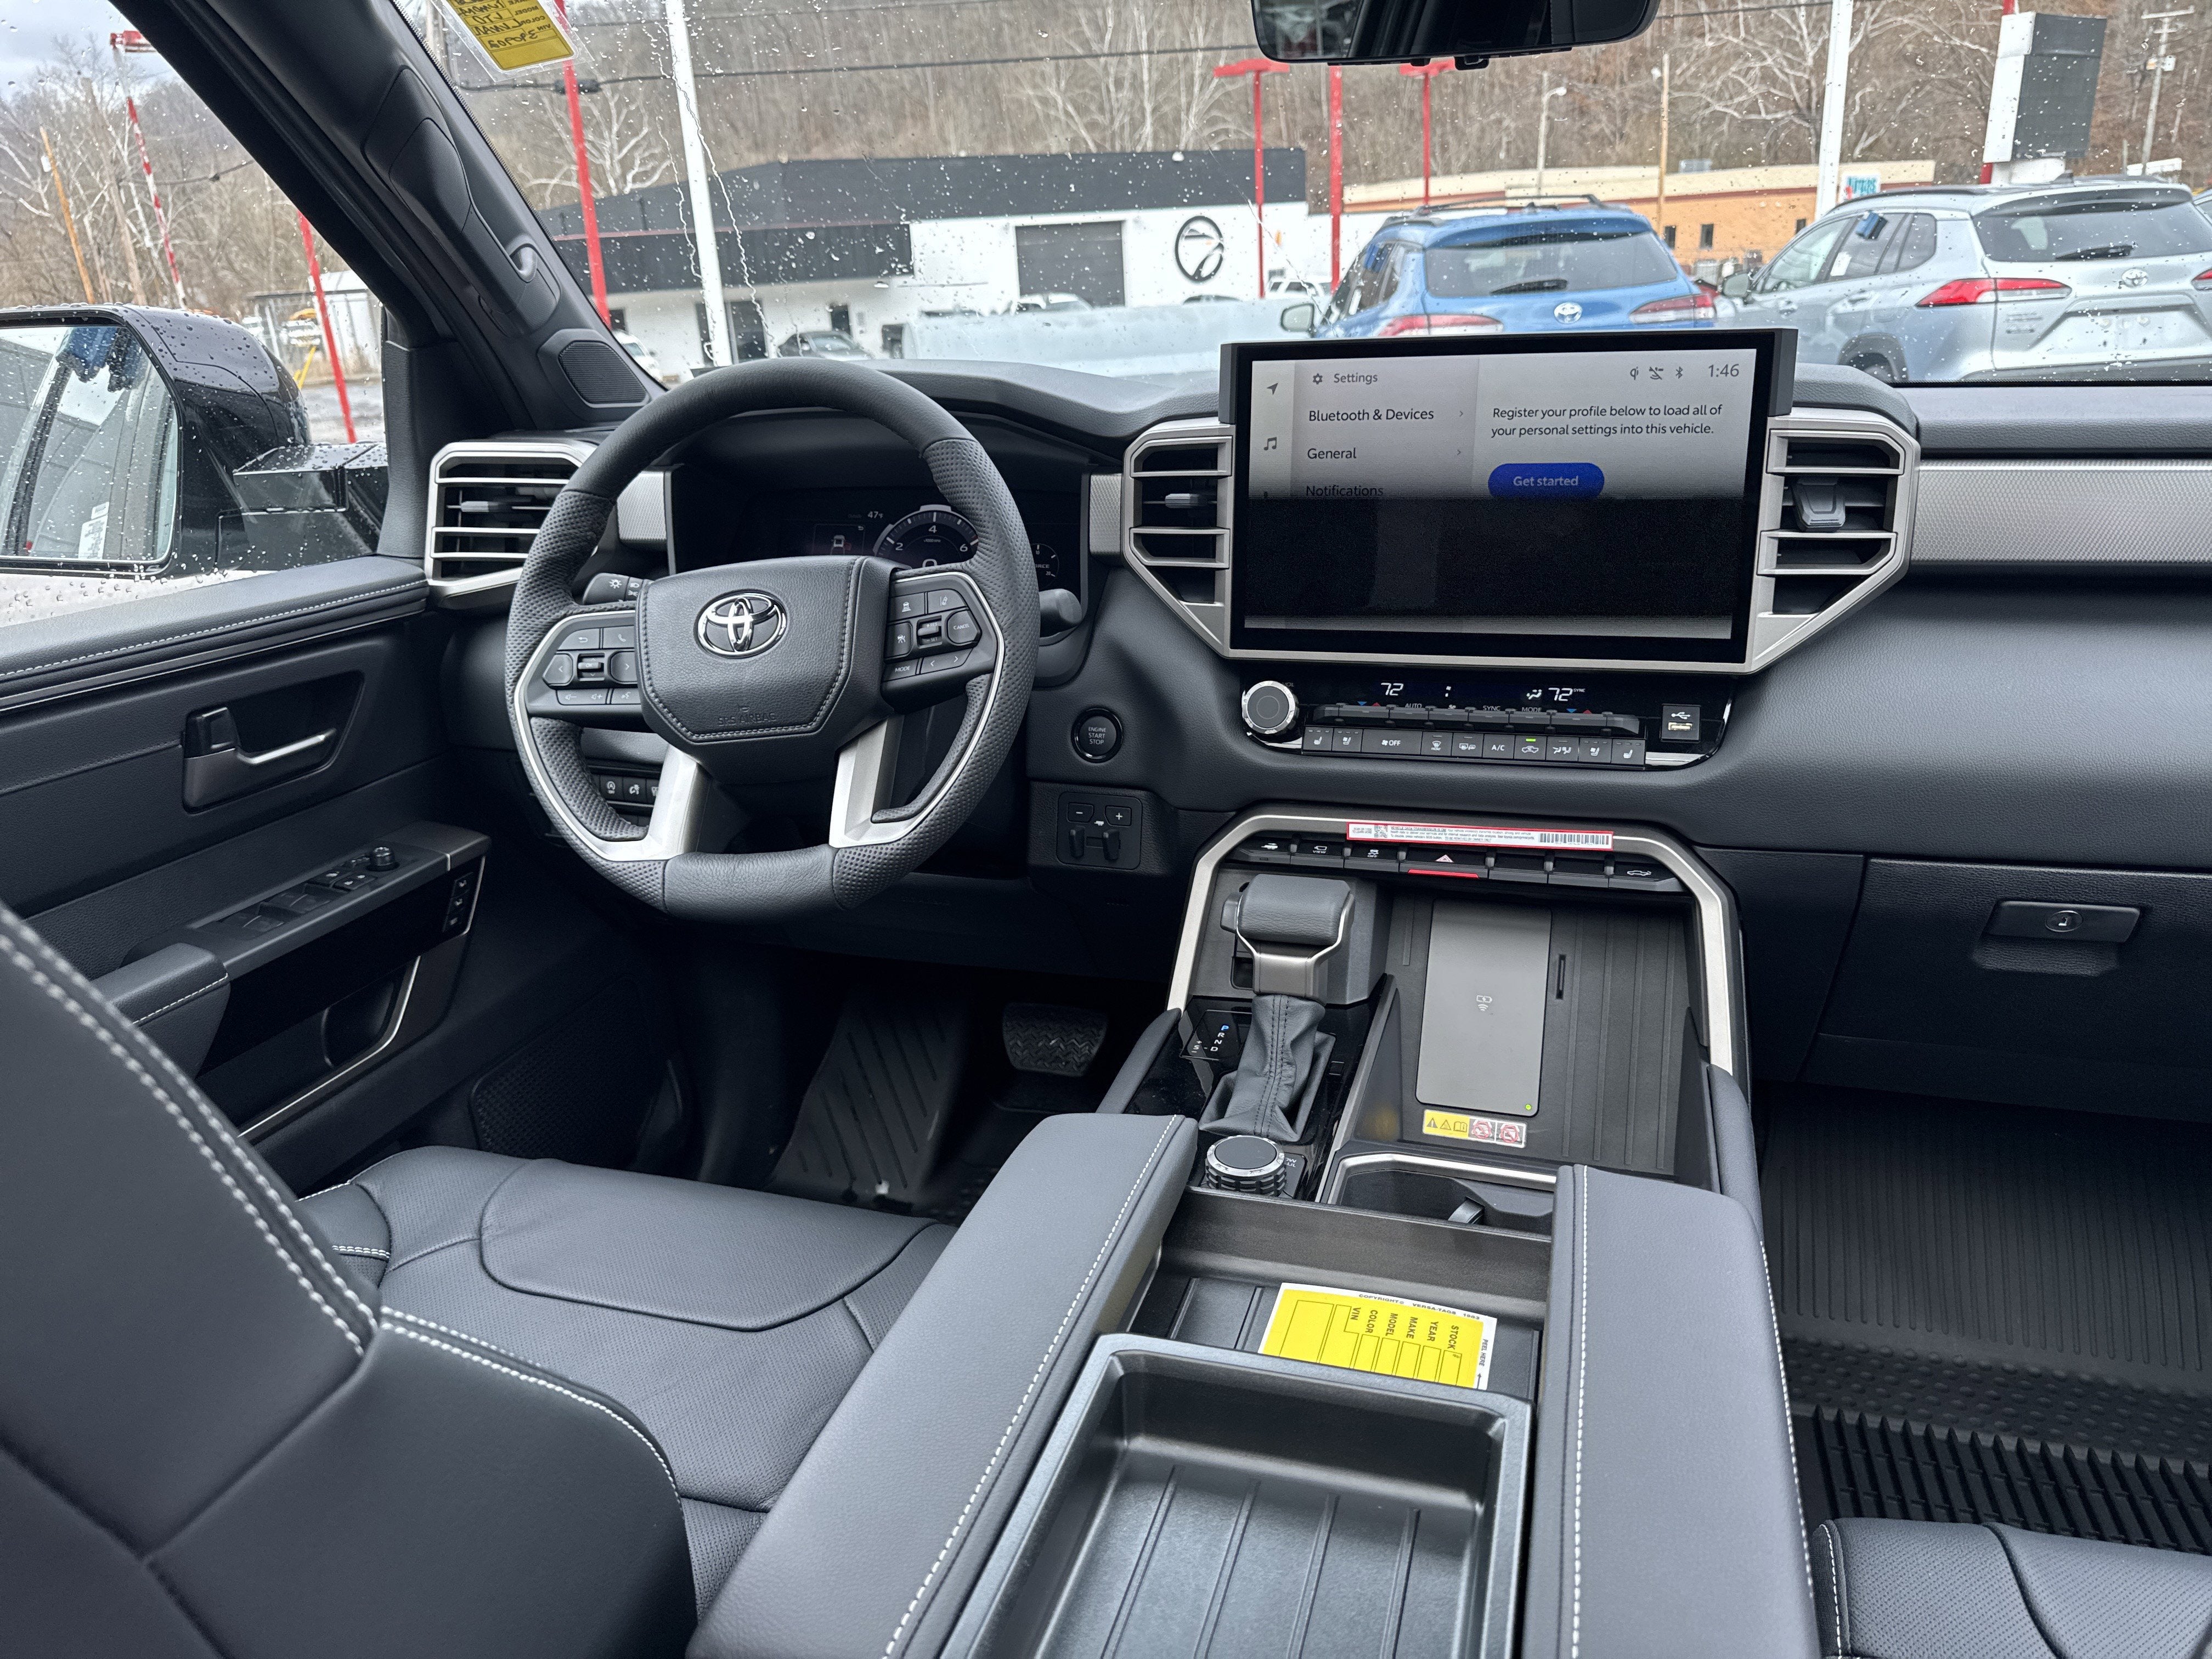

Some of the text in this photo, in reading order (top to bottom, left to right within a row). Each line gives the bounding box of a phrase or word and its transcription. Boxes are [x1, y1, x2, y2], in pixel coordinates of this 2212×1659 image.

[1708, 364, 1739, 377] 1:46
[1334, 373, 1378, 384] Settings
[1309, 408, 1434, 421] Bluetooth & Devices
[1493, 404, 1723, 420] Register your profile below to load all of
[1491, 423, 1714, 438] your personal settings into this vehicle.
[1307, 448, 1357, 459] General
[1513, 476, 1578, 486] Get started
[1306, 485, 1384, 497] Notifications
[929, 525, 937, 533] 4
[895, 543, 904, 551] 2
[959, 544, 968, 552] 6
[1380, 682, 1404, 696] 72
[1548, 687, 1573, 702] 72
[718, 713, 777, 727] SRS AIRBAG
[1350, 1307, 1362, 1321] VIN
[1412, 1303, 1457, 1314] VERSA-TAGS
[1365, 1310, 1378, 1333] COLOR
[1385, 1313, 1398, 1336] MODEL
[1406, 1316, 1419, 1339] MAKE
[1426, 1321, 1439, 1342] YEAR
[1447, 1325, 1459, 1350] STOCK
[1479, 1339, 1489, 1367] PEEL HERE
